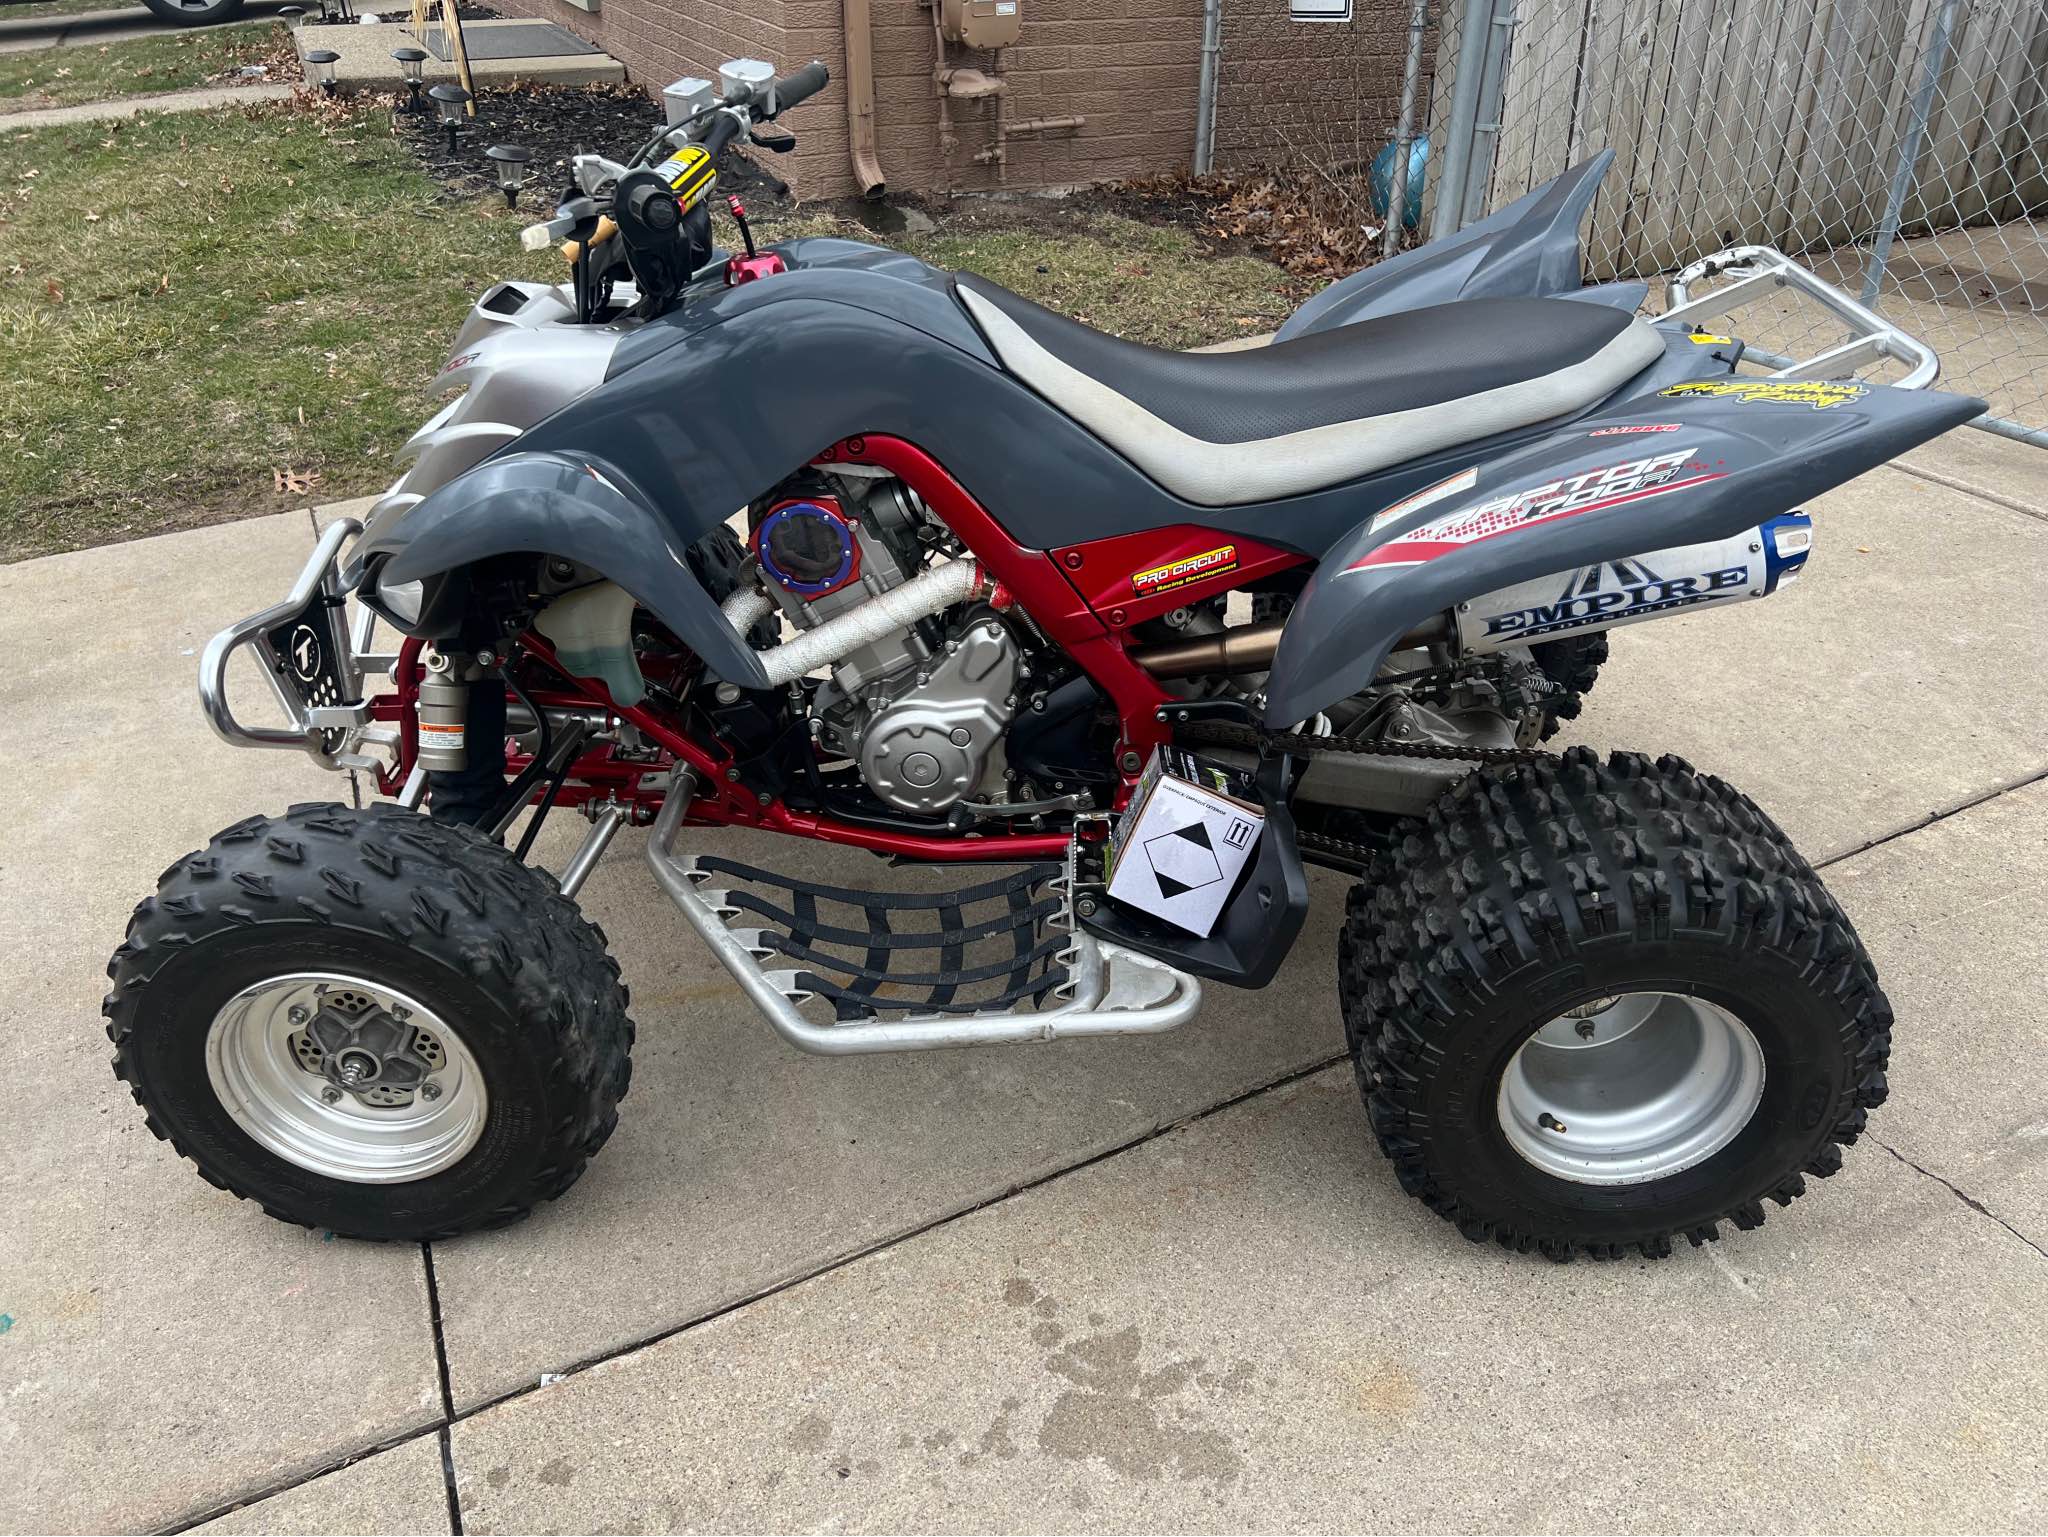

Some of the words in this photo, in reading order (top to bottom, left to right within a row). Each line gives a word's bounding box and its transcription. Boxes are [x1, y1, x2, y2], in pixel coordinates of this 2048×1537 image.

[1433, 448, 1699, 536] RAPTOR
[1530, 466, 1682, 516] 700R
[1137, 569, 1169, 587] PRO
[1172, 549, 1231, 576] CIRCUIT
[1156, 579, 1184, 592] Racing
[1185, 563, 1237, 583] Development
[1481, 566, 1748, 637] EMPIRE
[1521, 595, 1711, 637] INDUSTRIES
